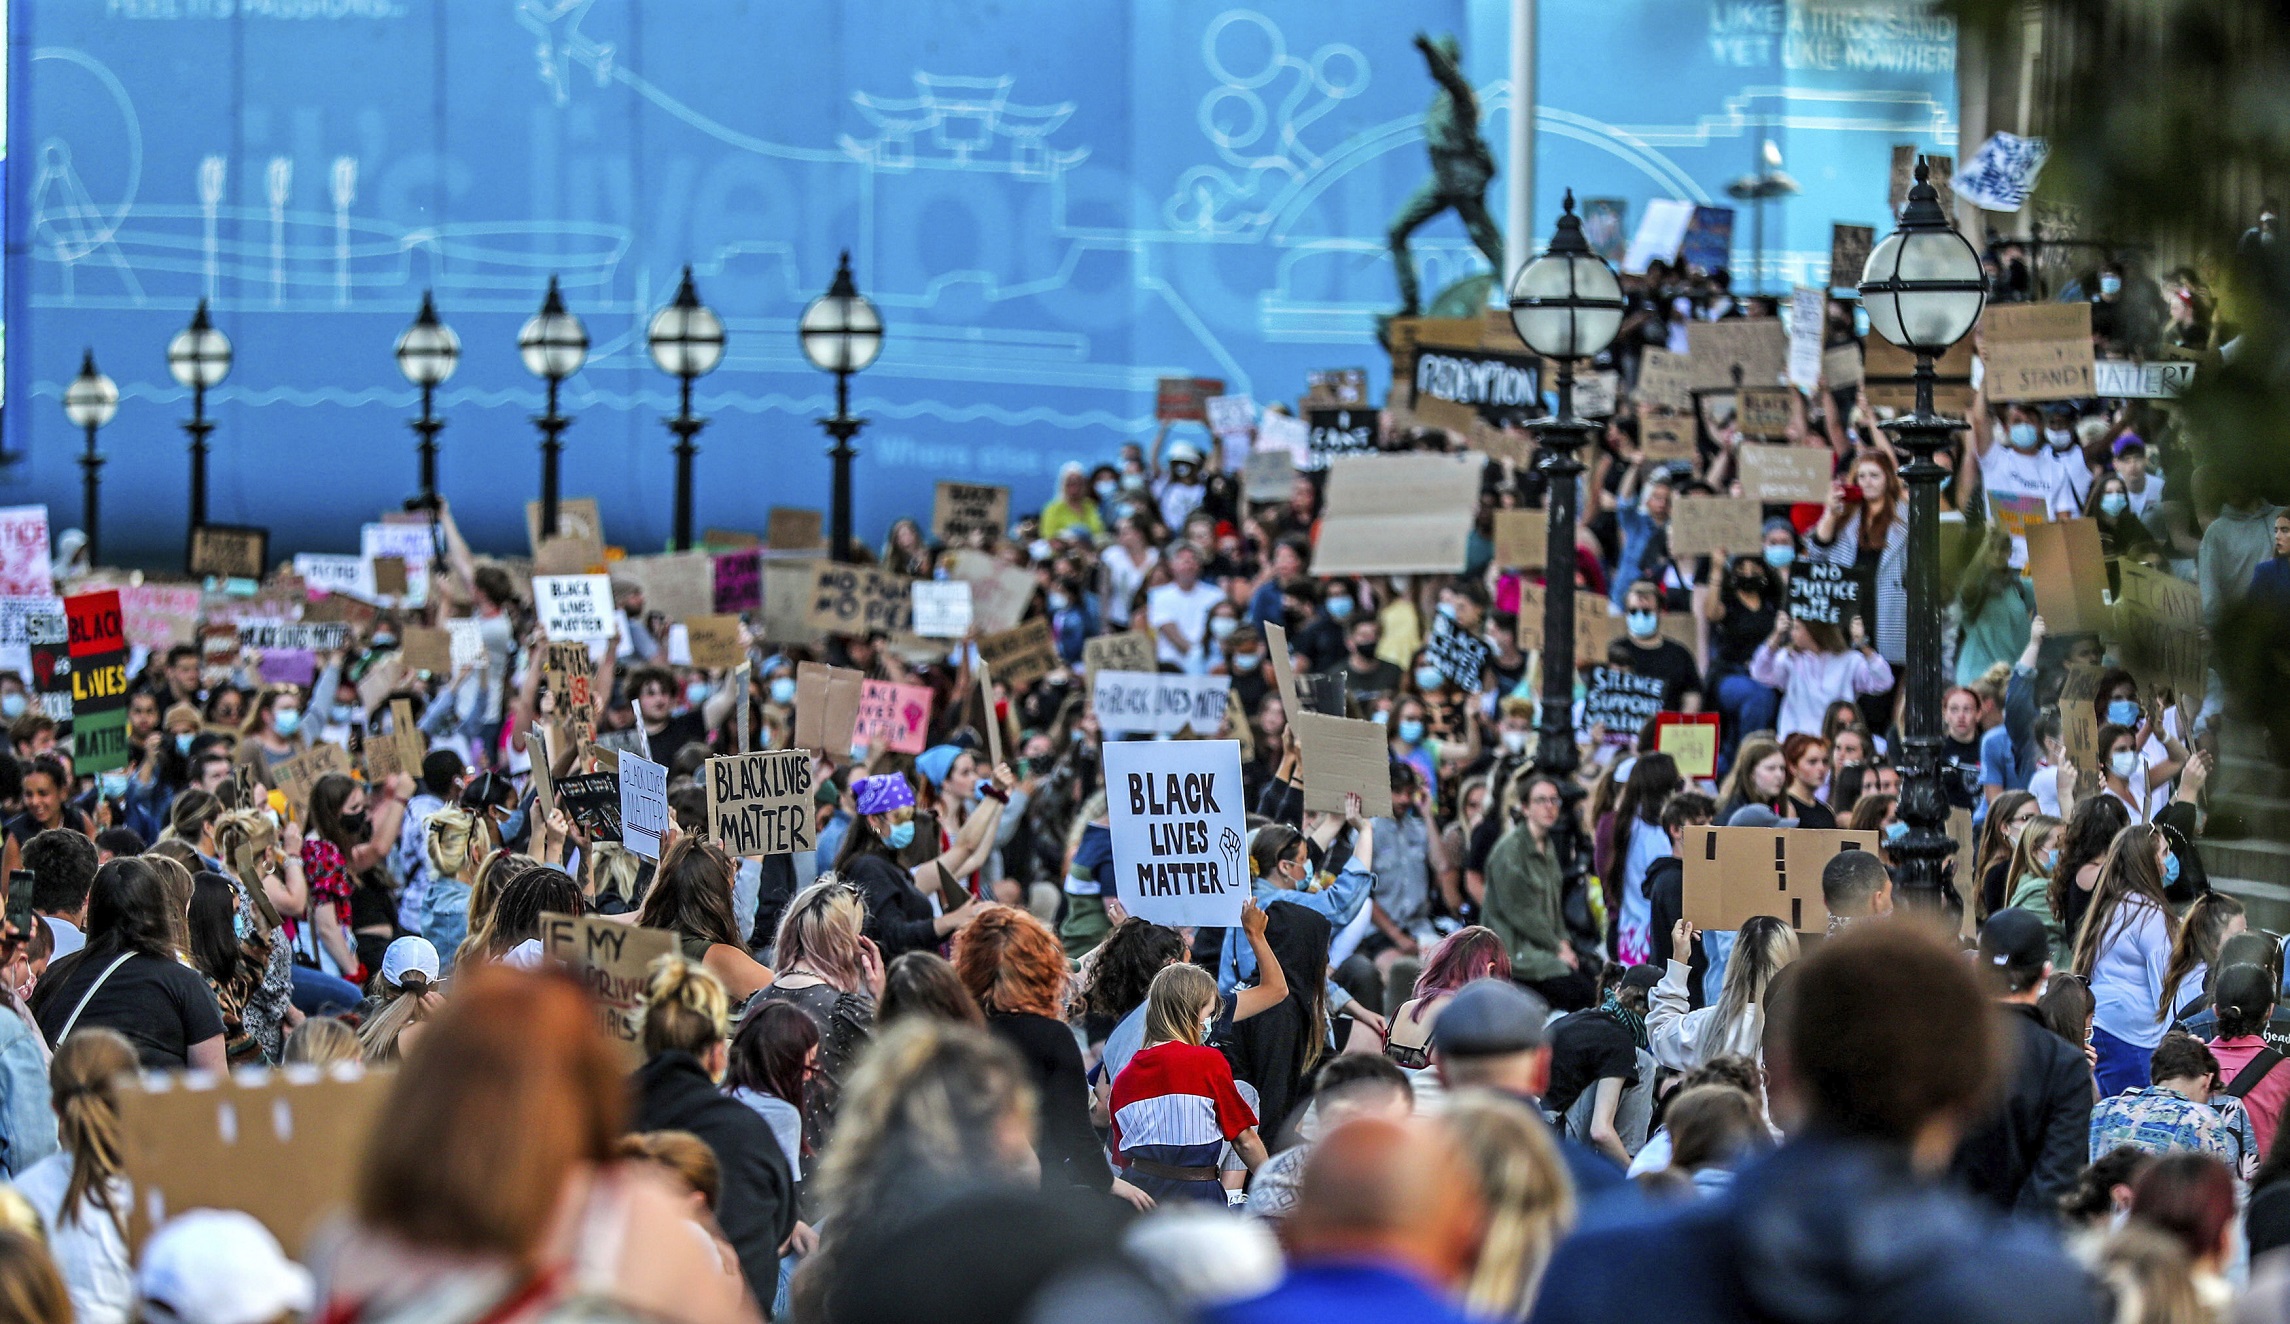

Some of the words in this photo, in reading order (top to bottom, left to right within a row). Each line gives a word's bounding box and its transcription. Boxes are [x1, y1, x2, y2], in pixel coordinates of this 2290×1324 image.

[550, 581, 591, 597] BLACK
[1789, 577, 1859, 602] JUSTICE
[1810, 564, 1842, 581] NO
[72, 664, 127, 701] LIVES
[1593, 667, 1665, 697] SILENCE
[1155, 686, 1192, 716] LIVES
[622, 759, 647, 790] BLACK
[646, 772, 665, 797] LIVES
[714, 756, 772, 804] BLACK
[772, 755, 811, 798] LIVES
[1127, 772, 1221, 816] BLACK
[626, 791, 667, 836] MATTER
[719, 803, 809, 854] MATTER
[1149, 819, 1210, 856] LIVES
[1136, 862, 1226, 897] MATTER
[586, 923, 628, 963] MY
